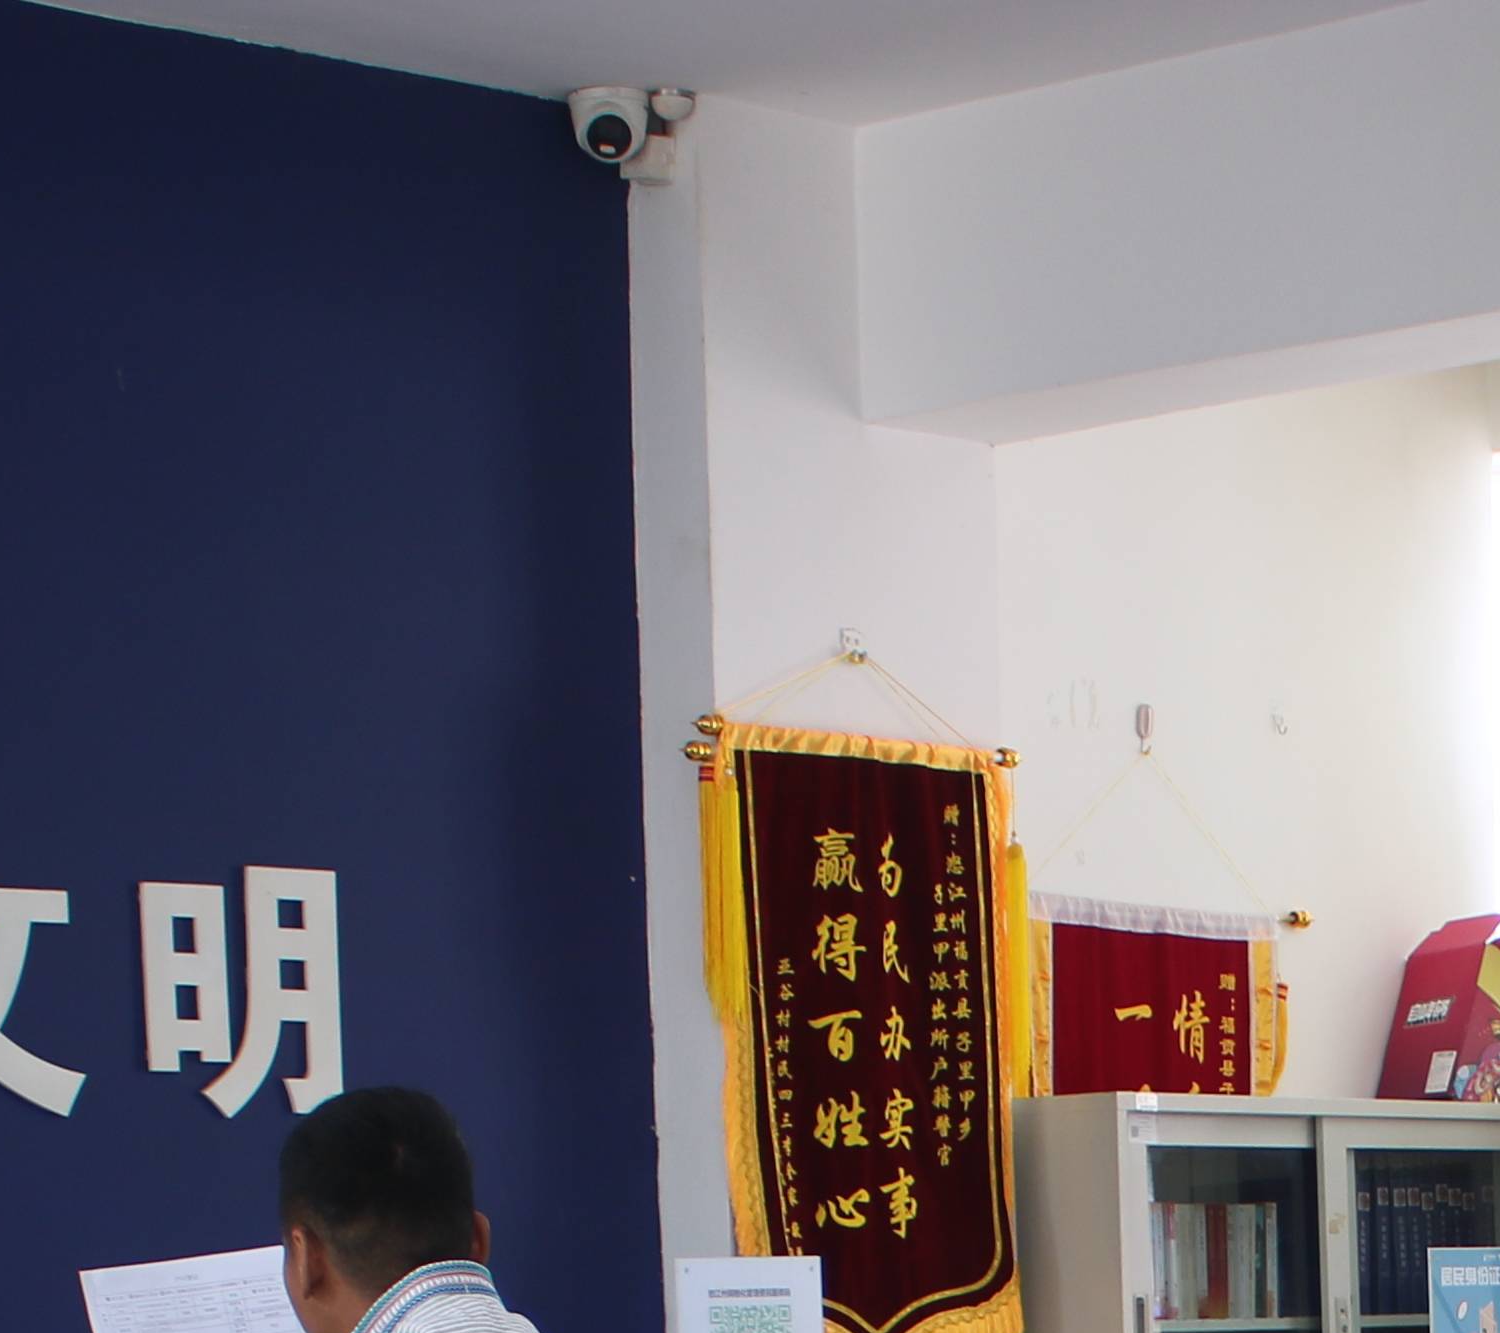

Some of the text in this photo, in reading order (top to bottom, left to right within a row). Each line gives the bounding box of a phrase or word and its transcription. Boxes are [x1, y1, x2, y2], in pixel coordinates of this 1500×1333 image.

[808, 828, 870, 1228] 赢得百姓心
